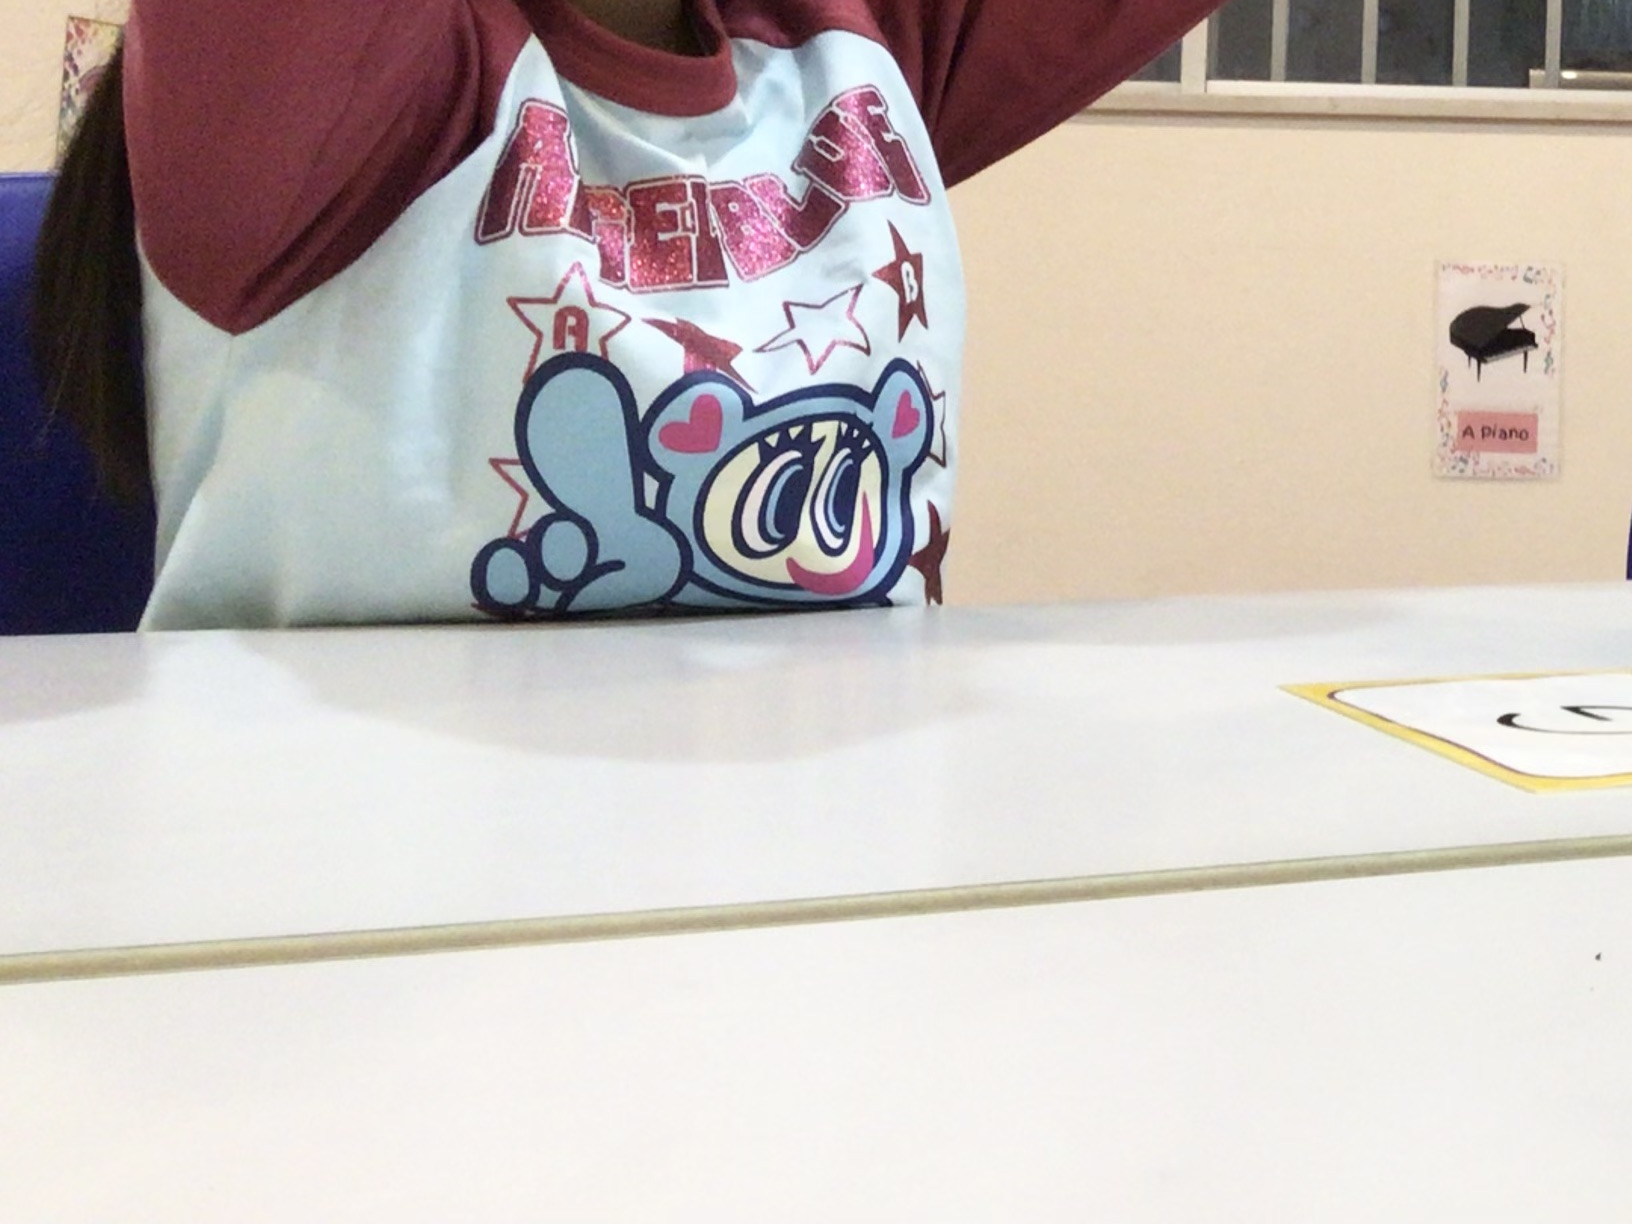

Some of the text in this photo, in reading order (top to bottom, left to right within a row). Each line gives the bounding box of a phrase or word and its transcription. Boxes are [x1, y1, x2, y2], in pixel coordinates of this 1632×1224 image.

[553, 306, 590, 354] A
[1461, 423, 1530, 443] A Piano
